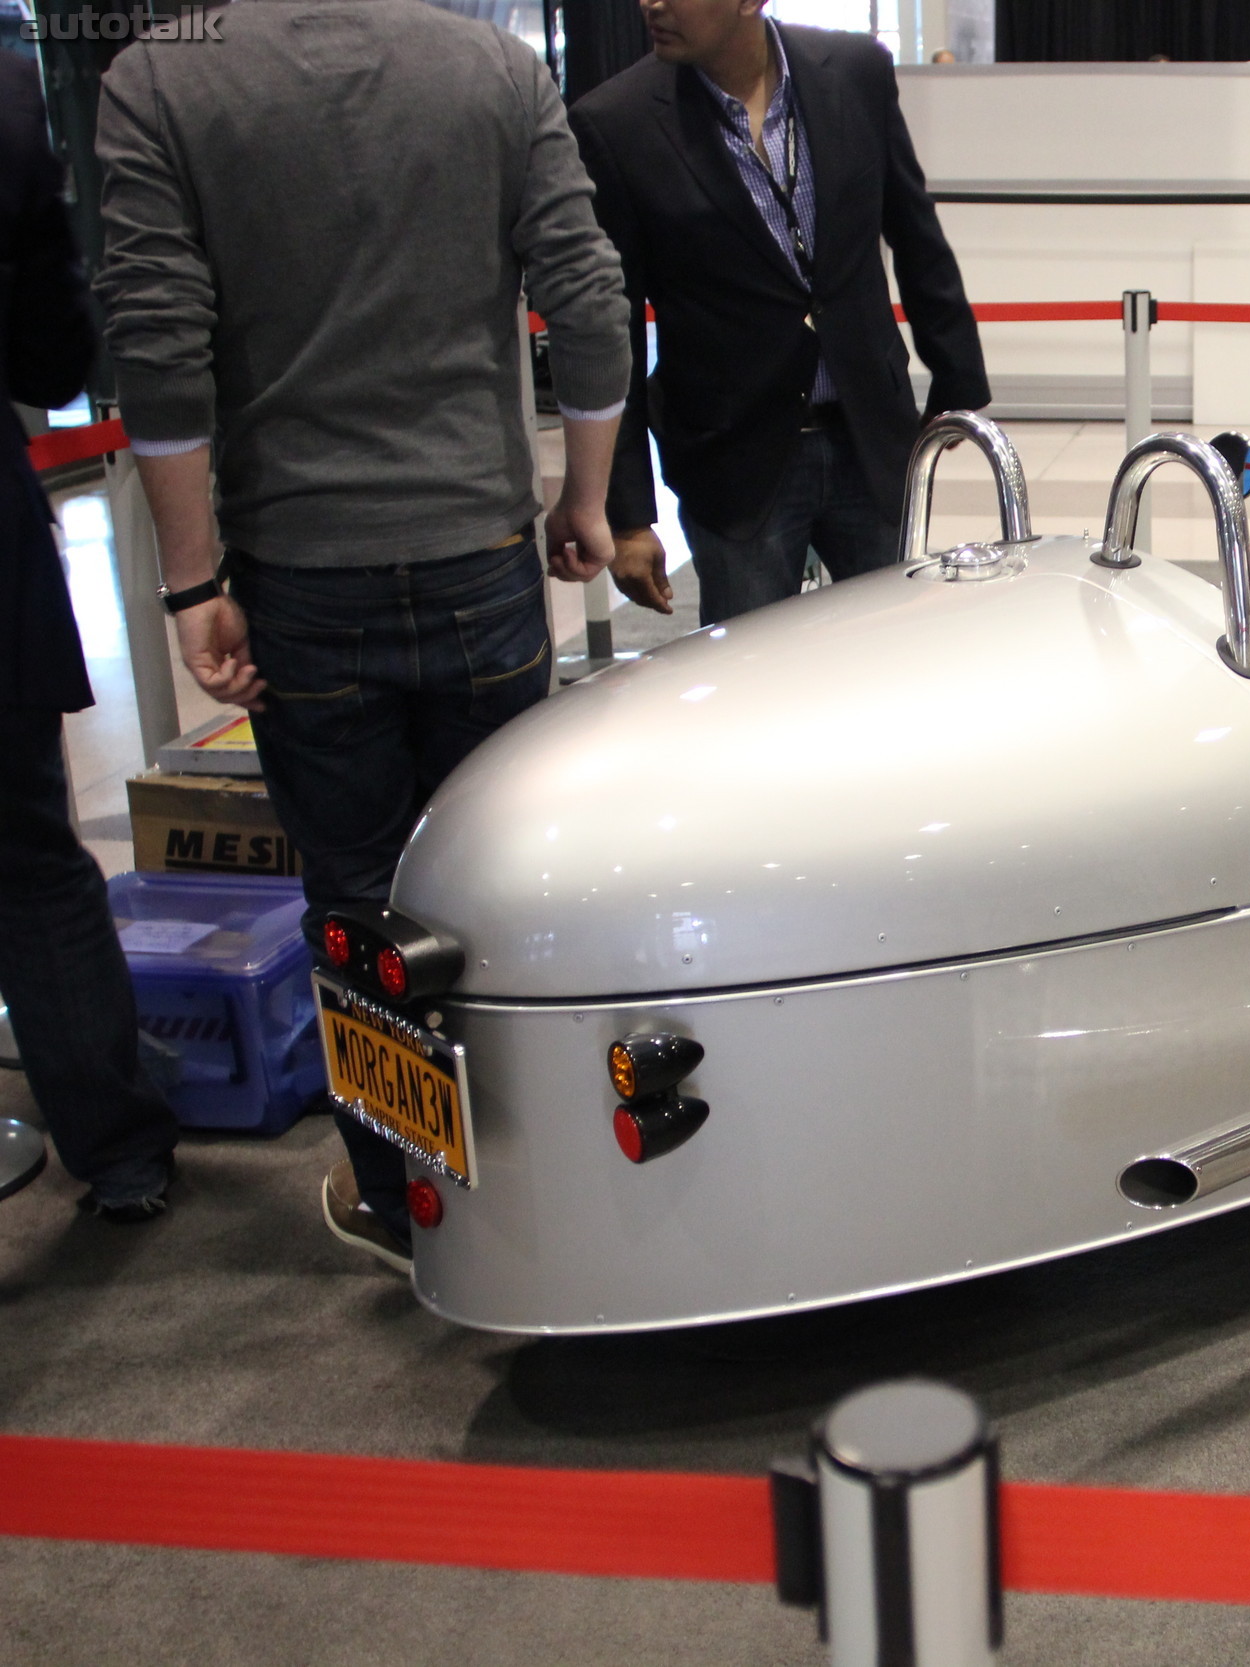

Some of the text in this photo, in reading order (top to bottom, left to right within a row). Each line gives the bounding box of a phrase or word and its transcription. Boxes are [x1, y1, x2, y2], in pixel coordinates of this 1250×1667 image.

[351, 1003, 384, 1032] NEW
[389, 1024, 426, 1056] YORK
[332, 1017, 455, 1148] MORGAN3W
[364, 1100, 400, 1133] EMPIRE
[405, 1126, 435, 1152] STATE
